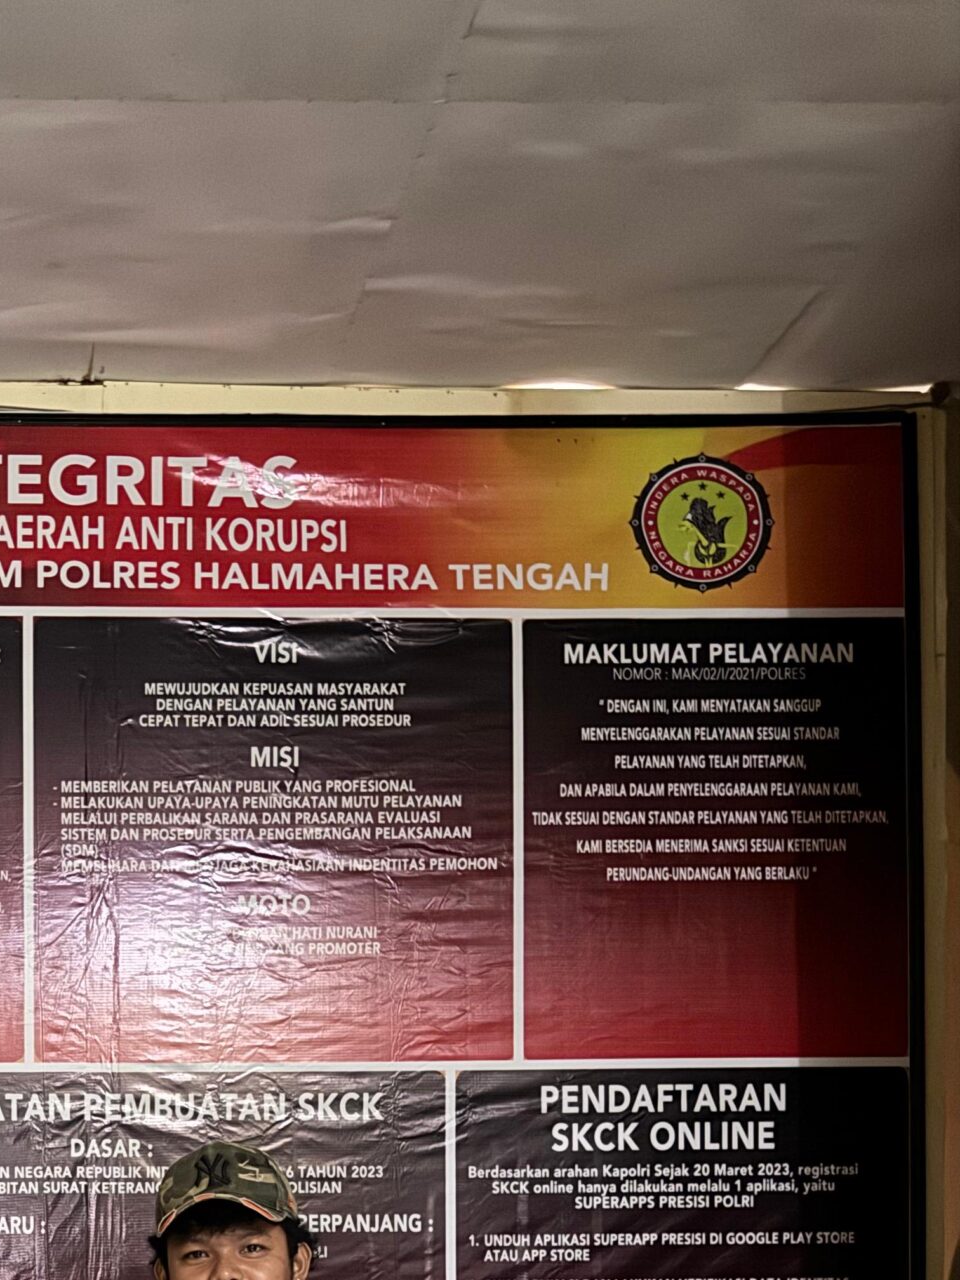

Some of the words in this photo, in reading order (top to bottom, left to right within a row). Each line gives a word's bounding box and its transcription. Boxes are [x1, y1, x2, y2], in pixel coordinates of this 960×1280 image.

[648, 472, 688, 515] INDERA
[697, 469, 755, 512] WASPADA
[116, 516, 192, 550] ANTI
[206, 518, 346, 552] KORUPSI
[648, 531, 694, 577] NEGARA
[702, 532, 756, 577] RAHARJA
[37, 560, 180, 589] POLRES
[195, 562, 438, 590] HALMAHERA
[449, 563, 608, 591] TENGAH
[255, 641, 299, 665] VISI
[564, 643, 701, 663] MAKLUMAT
[710, 643, 853, 663] PELAYANAN
[613, 668, 661, 680] NOMOR
[672, 667, 805, 680] MAK/02/I/2021/POLRES
[145, 683, 239, 695] MEWUJUDKAN
[244, 683, 312, 695] KEPUASAN
[318, 683, 405, 695] MASYARAKAT
[157, 699, 212, 711] DENGAN
[217, 699, 295, 711] PELAYANAN
[299, 699, 336, 711] YANG
[341, 699, 393, 711] SANTUN
[250, 745, 300, 768] MISI
[82, 1092, 287, 1123] PEMBUATAN
[298, 1091, 382, 1122] SKCK
[541, 1084, 785, 1113] PENDAFTARAN
[70, 1138, 141, 1158] DASAR
[552, 1122, 639, 1151] SKCK
[650, 1122, 775, 1150] ONLINE
[468, 1164, 549, 1179] Berdasarkan
[553, 1164, 598, 1179] arahan
[602, 1164, 650, 1182] Kapolri
[655, 1164, 689, 1182] Sejak
[693, 1164, 711, 1178] 20
[714, 1163, 753, 1177] Maret
[757, 1163, 794, 1180] 2023,
[798, 1163, 859, 1179] registrasi
